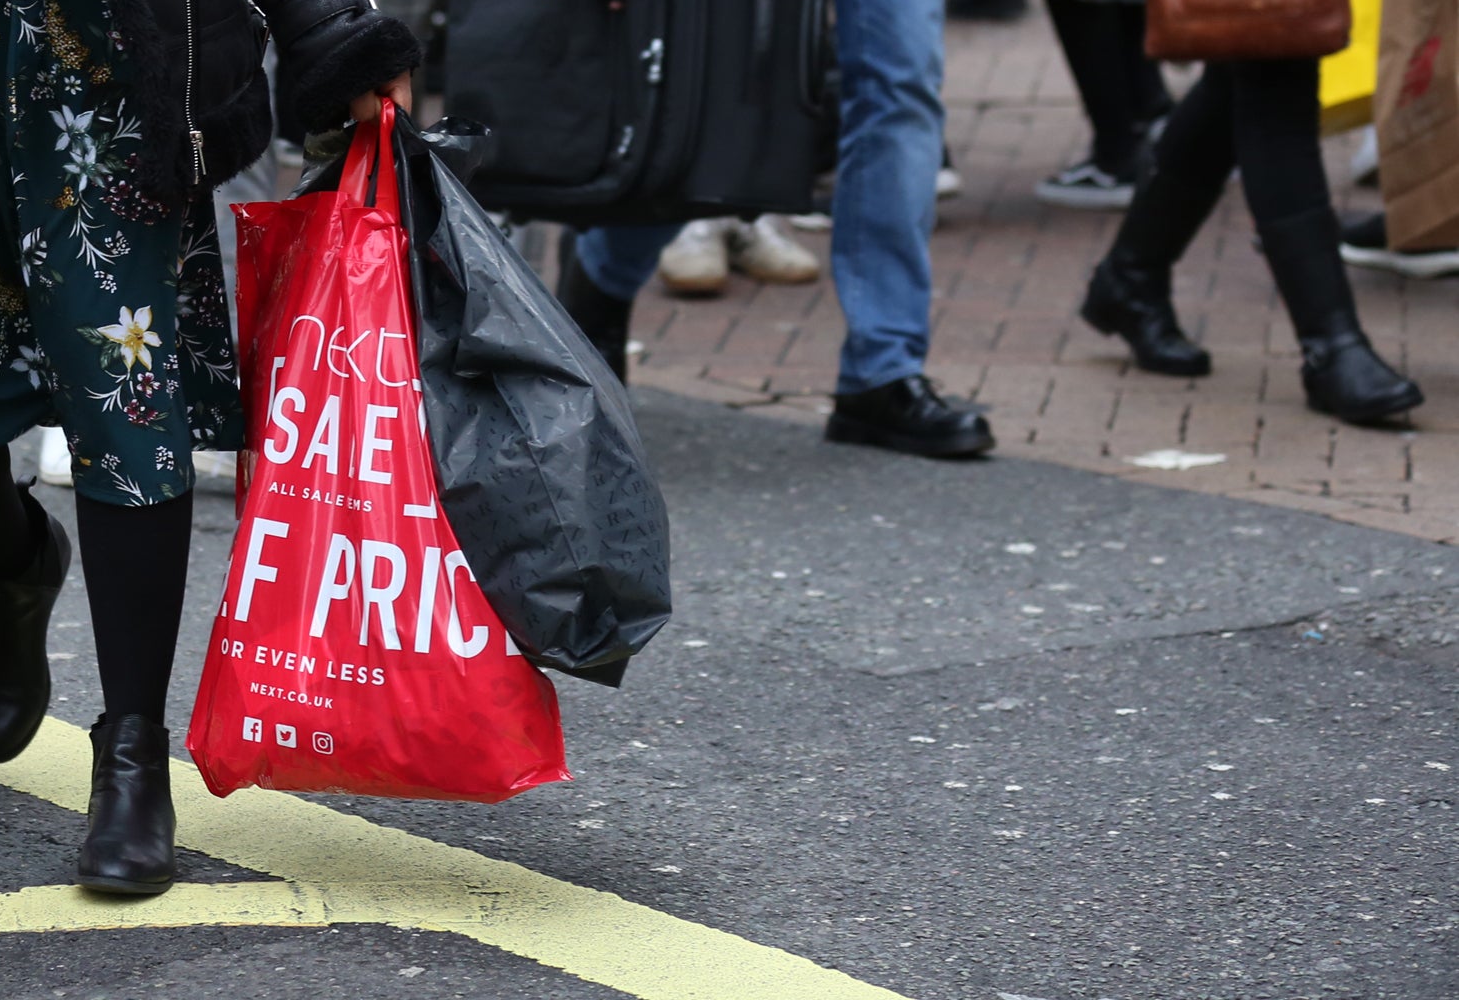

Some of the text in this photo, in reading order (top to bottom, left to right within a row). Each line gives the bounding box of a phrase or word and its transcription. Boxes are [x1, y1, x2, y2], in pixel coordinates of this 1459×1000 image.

[288, 314, 408, 387] next
[268, 480, 373, 512] ALL SALE EMS
[309, 532, 523, 659] PRIC
[221, 637, 386, 686] OR EVEN LESS
[250, 682, 334, 710] NEXT.CO.UK
